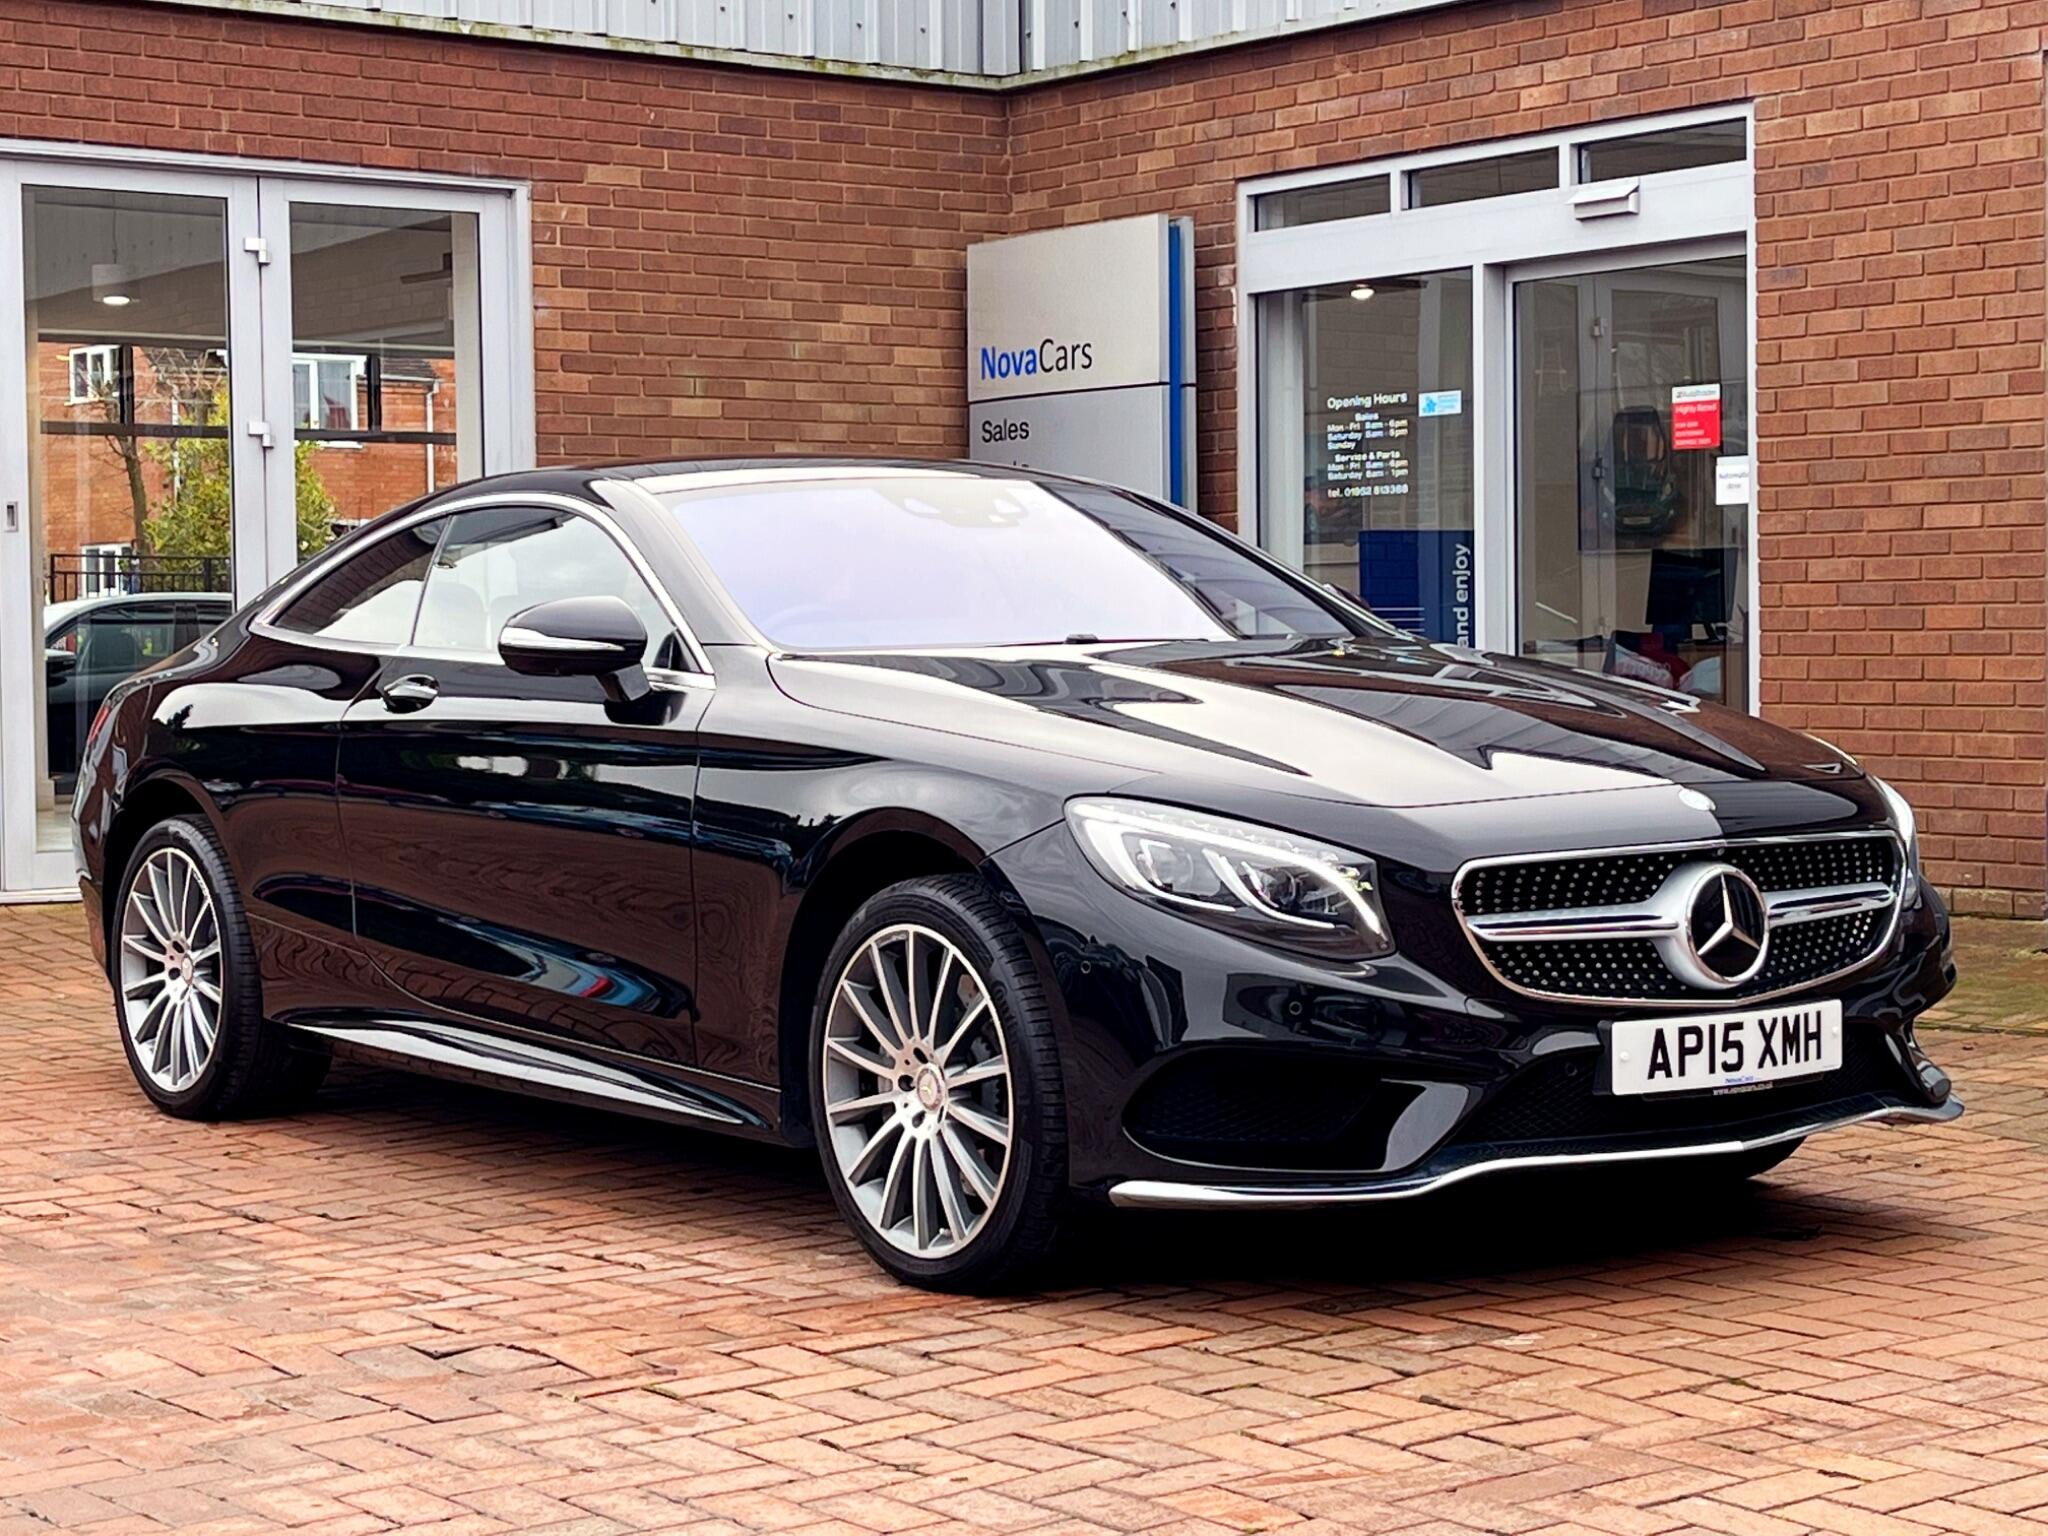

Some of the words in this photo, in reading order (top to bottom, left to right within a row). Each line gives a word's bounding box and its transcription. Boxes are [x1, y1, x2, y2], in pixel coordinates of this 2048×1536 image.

[981, 338, 1093, 380] NovaCars
[1327, 395, 1372, 410] Opening
[1373, 392, 1408, 404] Hours
[1354, 412, 1379, 421] Sales
[982, 418, 1030, 443] Sales
[1327, 424, 1344, 432] Mon
[1349, 422, 1361, 430] Fri
[1327, 432, 1363, 441] Saturday
[1328, 441, 1356, 450] Sunday
[1334, 453, 1367, 462] Service
[1369, 452, 1375, 460] &
[1376, 450, 1401, 459] Parts
[1328, 463, 1344, 471] Mon
[1349, 462, 1361, 470] Fri
[1328, 472, 1363, 481] Saturday
[1391, 469, 1408, 478] 1pm
[1328, 488, 1343, 498] tel.
[1452, 543, 1471, 602] enjoy
[1452, 606, 1470, 648] and
[1647, 1021, 1744, 1080] AP15
[1757, 1010, 1822, 1069] XMH
